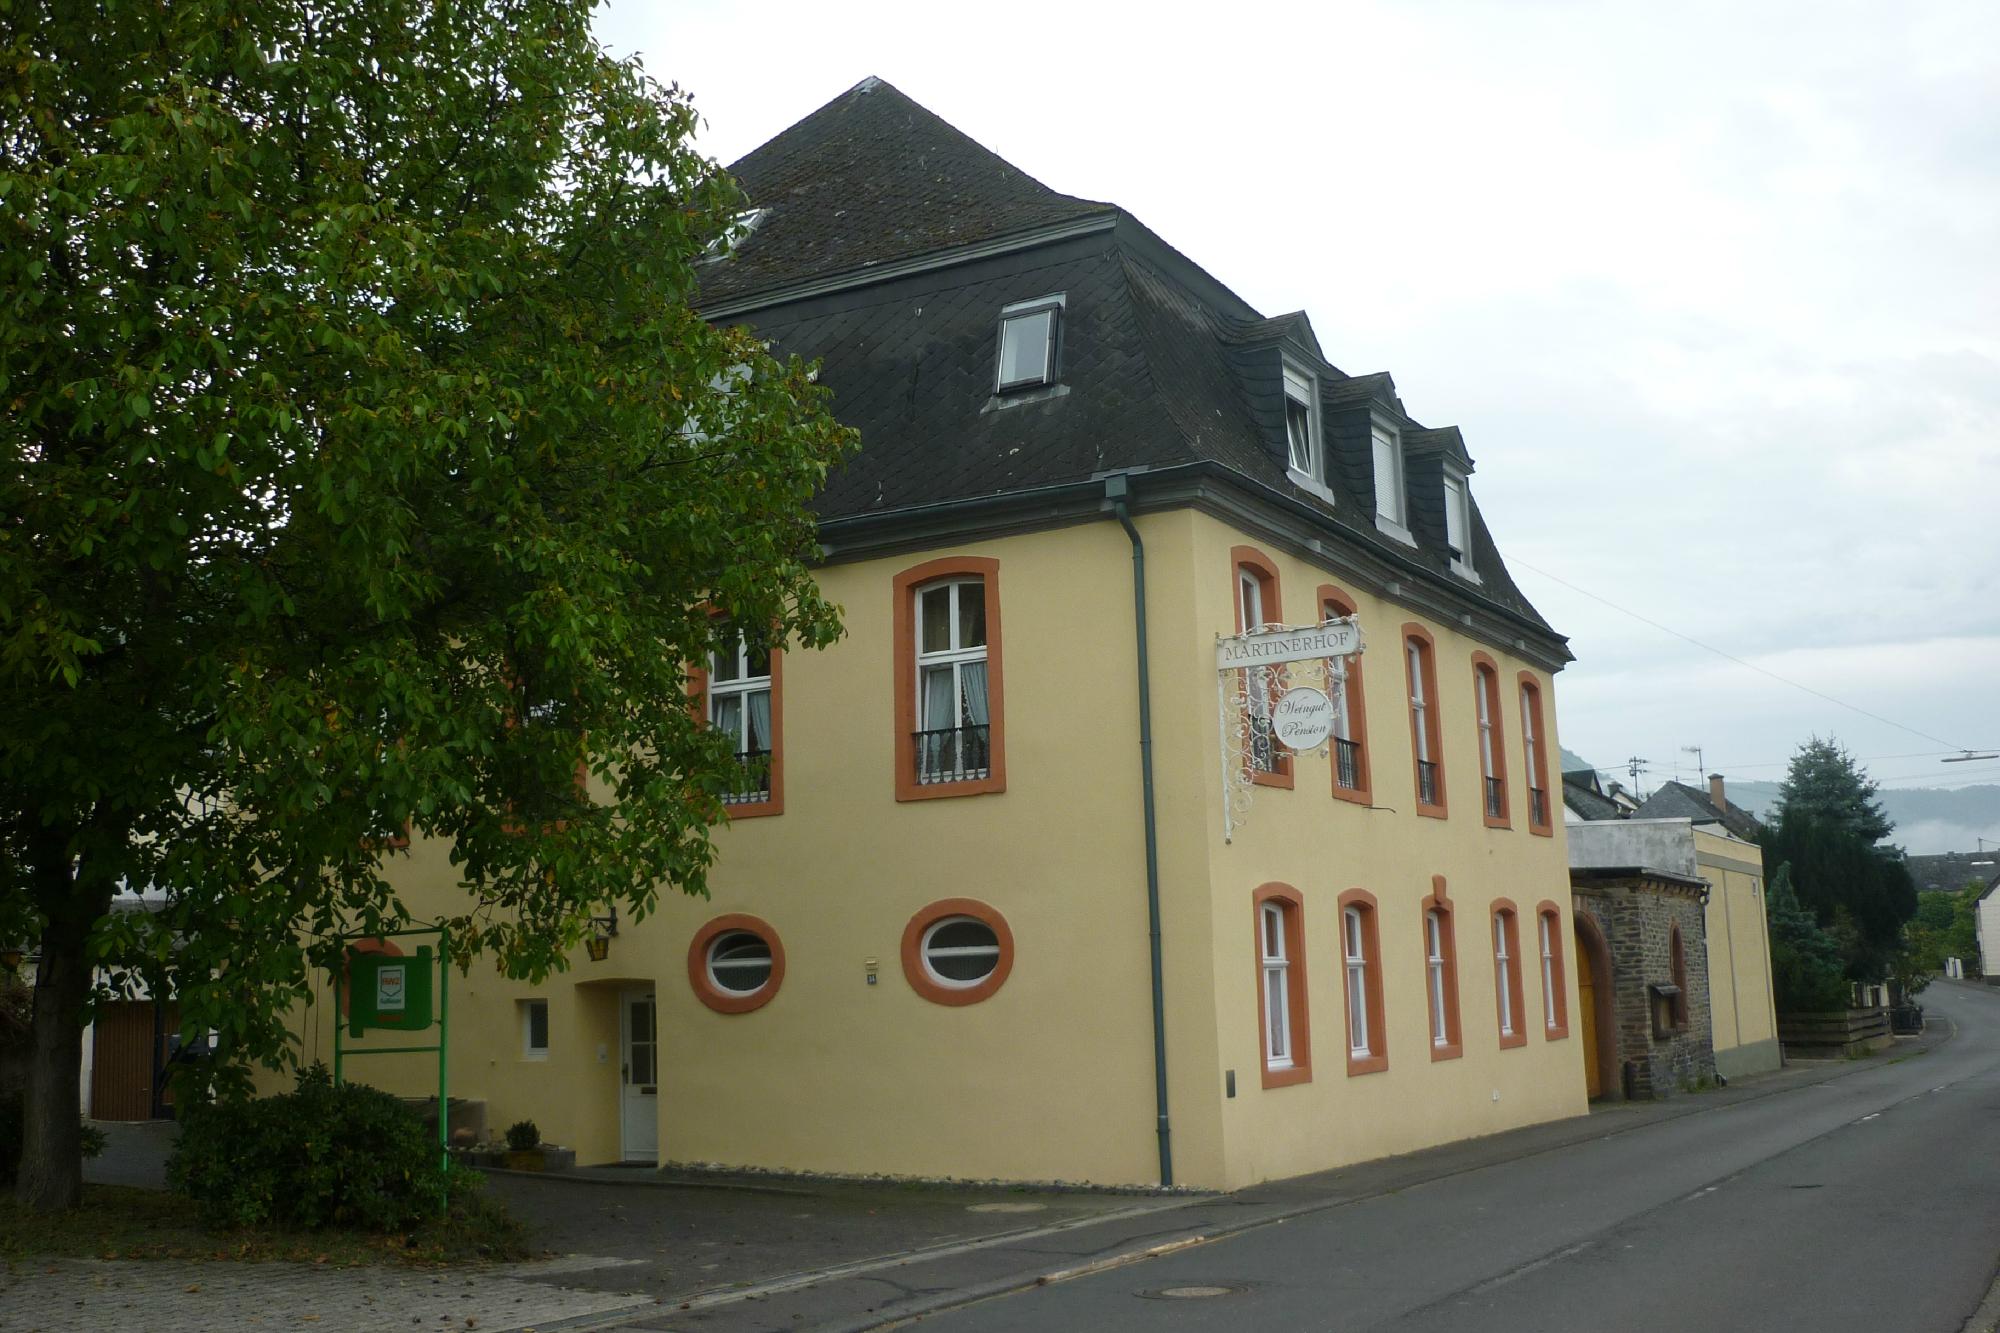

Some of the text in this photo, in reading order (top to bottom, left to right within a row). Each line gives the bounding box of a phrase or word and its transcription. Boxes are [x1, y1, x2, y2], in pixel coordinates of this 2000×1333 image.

[1225, 631, 1349, 661] MARTINERHOF
[1279, 698, 1327, 717] Weingut
[1281, 720, 1327, 738] Pension
